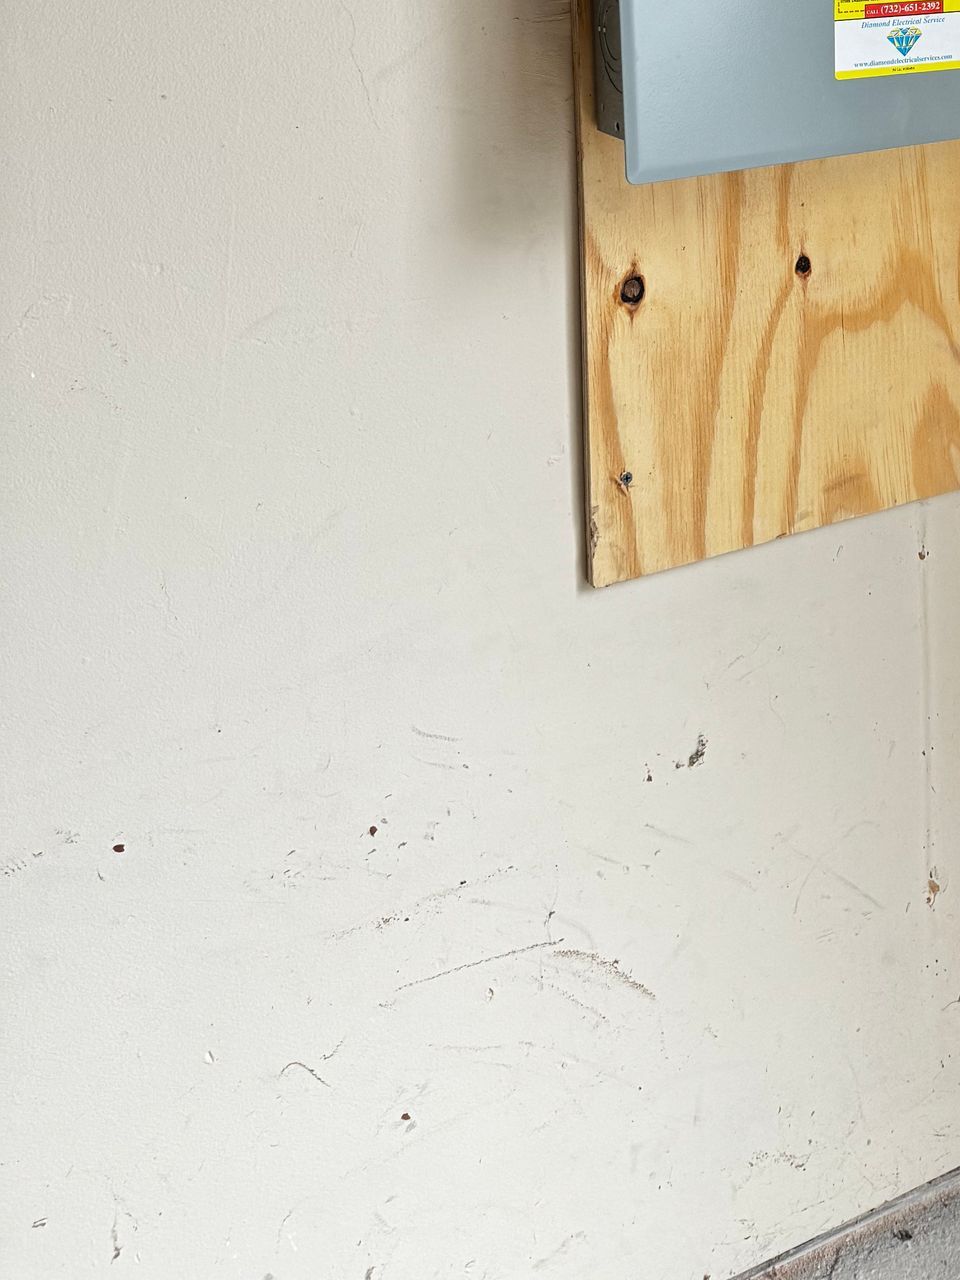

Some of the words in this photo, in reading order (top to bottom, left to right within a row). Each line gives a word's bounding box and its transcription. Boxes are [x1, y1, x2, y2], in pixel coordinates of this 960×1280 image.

[881, 2, 940, 14] (732)-651-2392
[862, 20, 890, 29] Diamond
[892, 17, 922, 26] Electrical
[923, 16, 945, 24] Service
[854, 54, 952, 68] www.diamondelectricalservices.com
